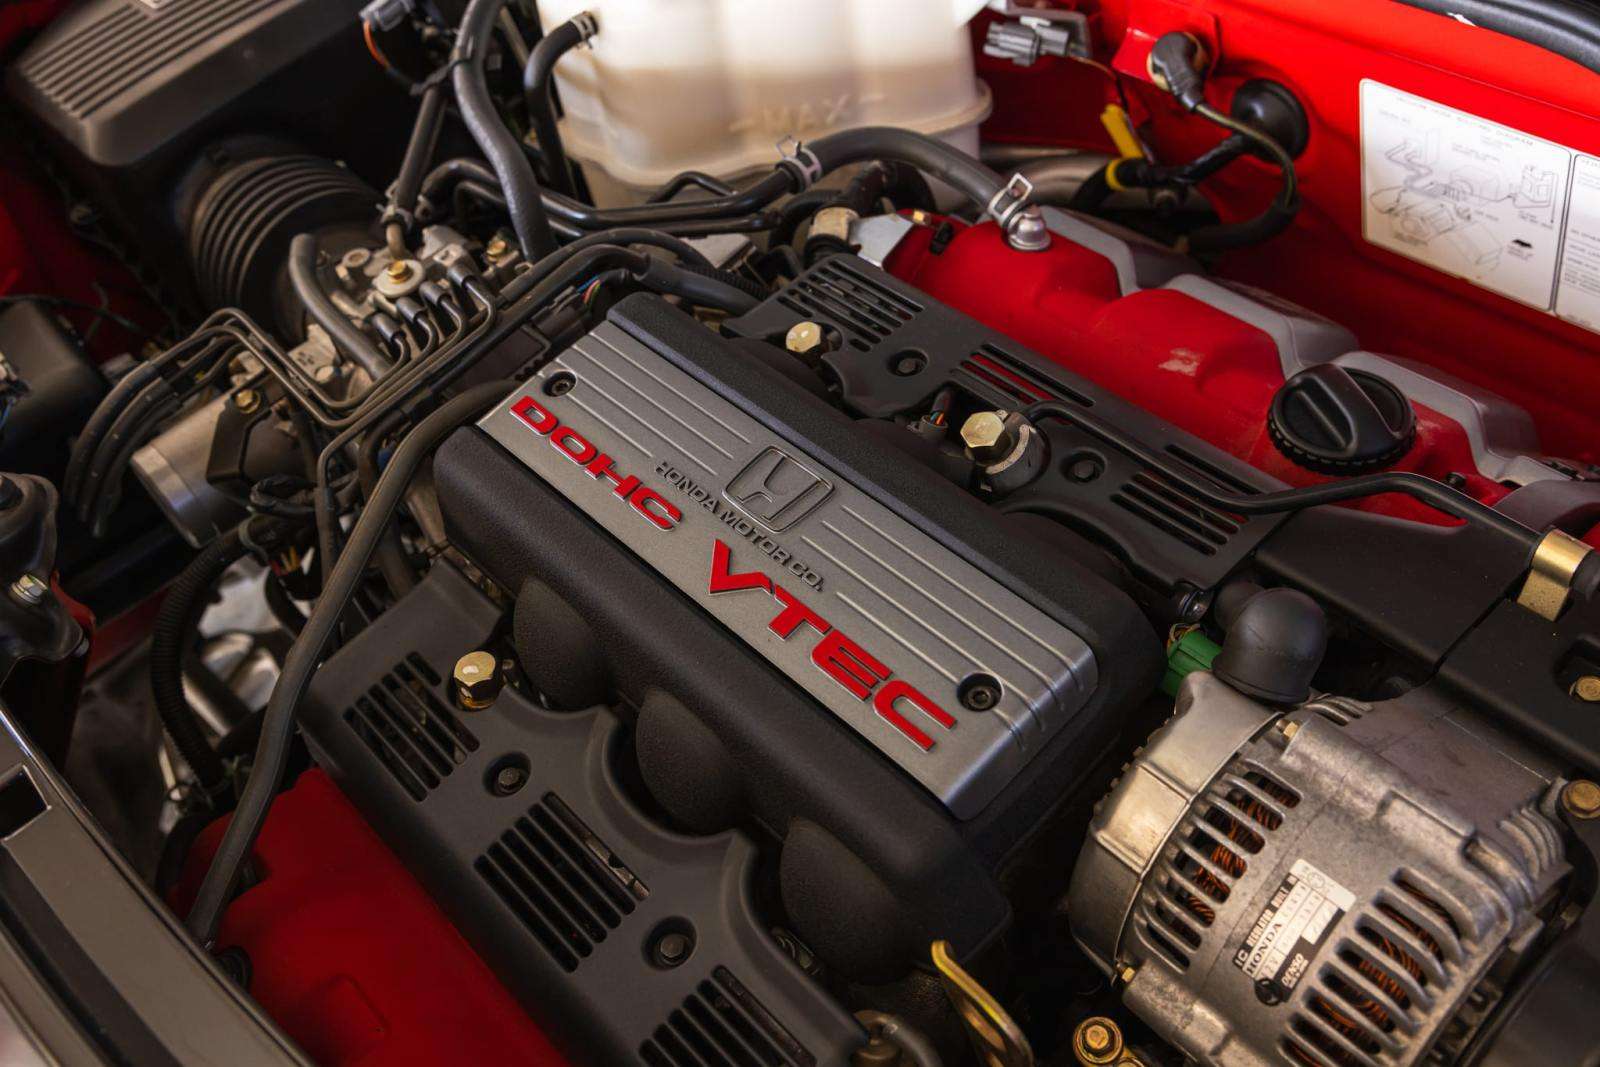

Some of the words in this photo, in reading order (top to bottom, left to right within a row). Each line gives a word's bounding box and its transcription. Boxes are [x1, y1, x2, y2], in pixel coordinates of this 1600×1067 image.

[760, 93, 852, 131] MAX
[509, 395, 682, 532] DOHC
[655, 461, 720, 514] HONDA
[720, 509, 792, 567] MOTOR
[708, 538, 957, 754] VTEC
[1246, 922, 1282, 975] HONDA
